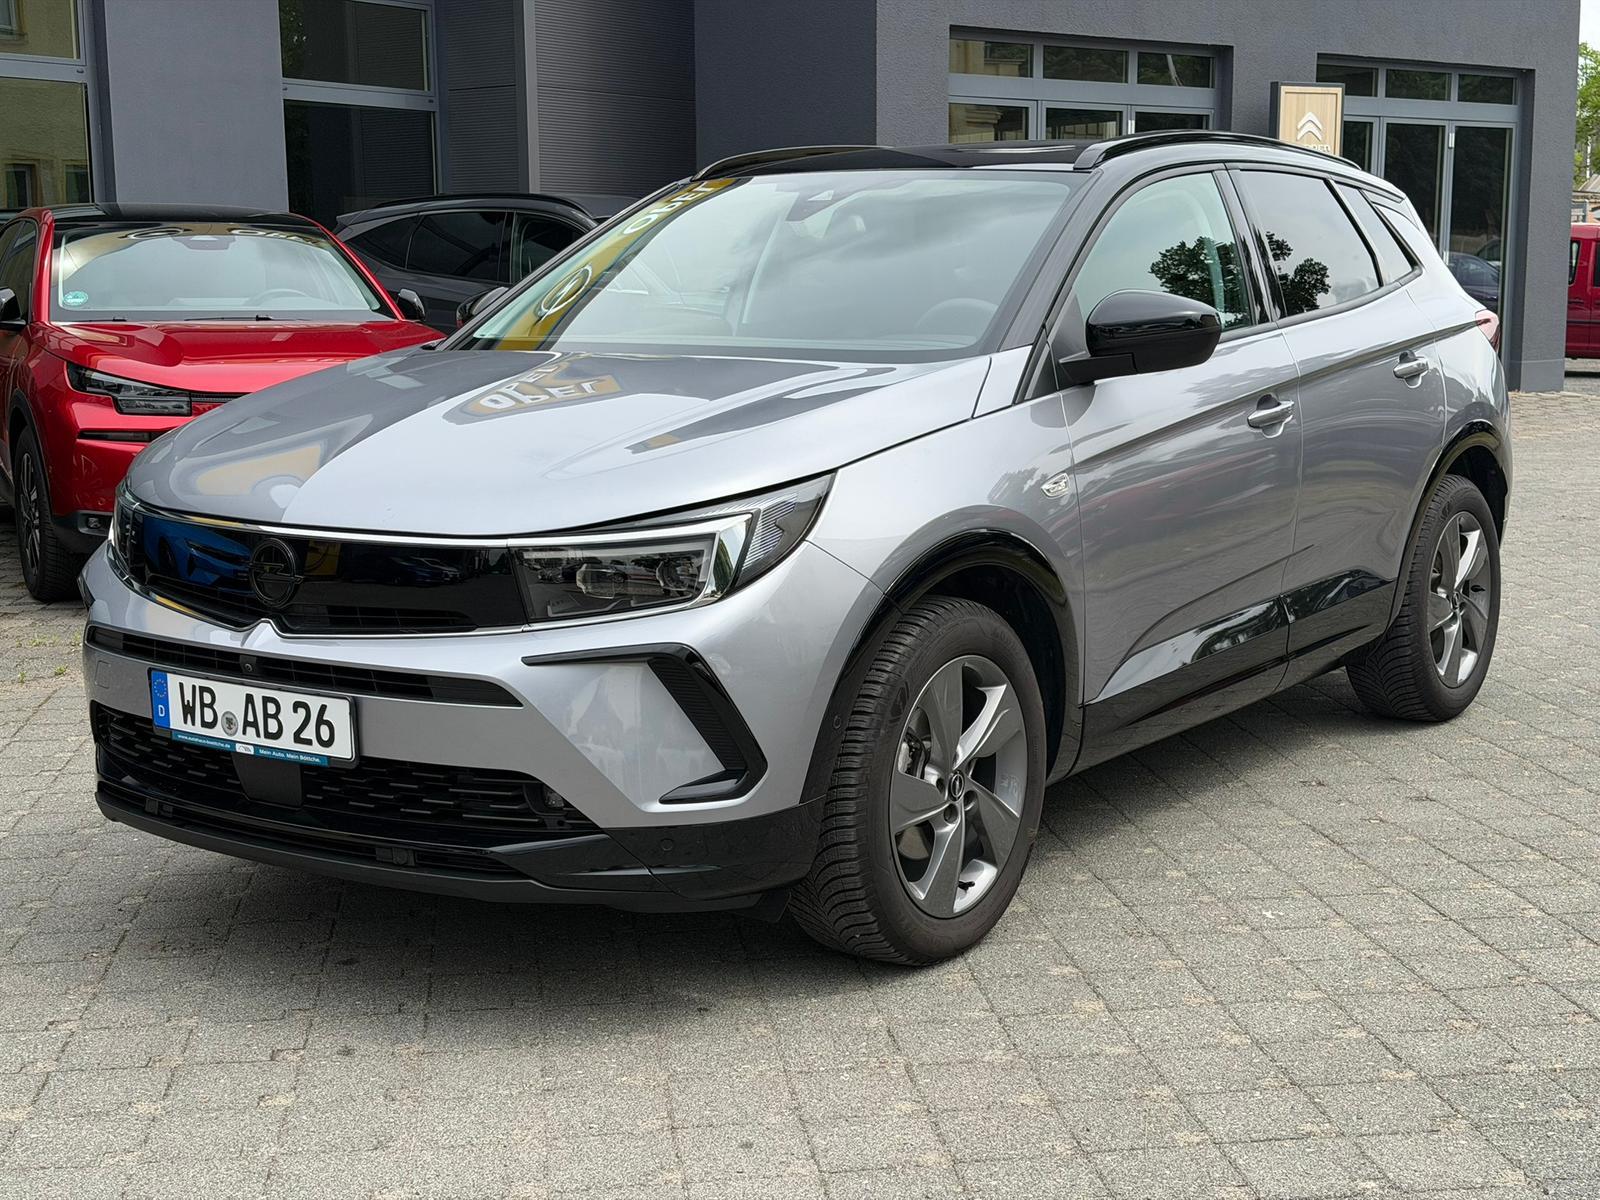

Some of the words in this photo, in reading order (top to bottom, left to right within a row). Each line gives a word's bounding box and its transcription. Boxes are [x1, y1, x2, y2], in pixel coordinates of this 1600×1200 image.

[158, 704, 166, 717] D
[178, 682, 218, 730] WB
[242, 693, 284, 741] AB
[292, 701, 335, 748] 26
